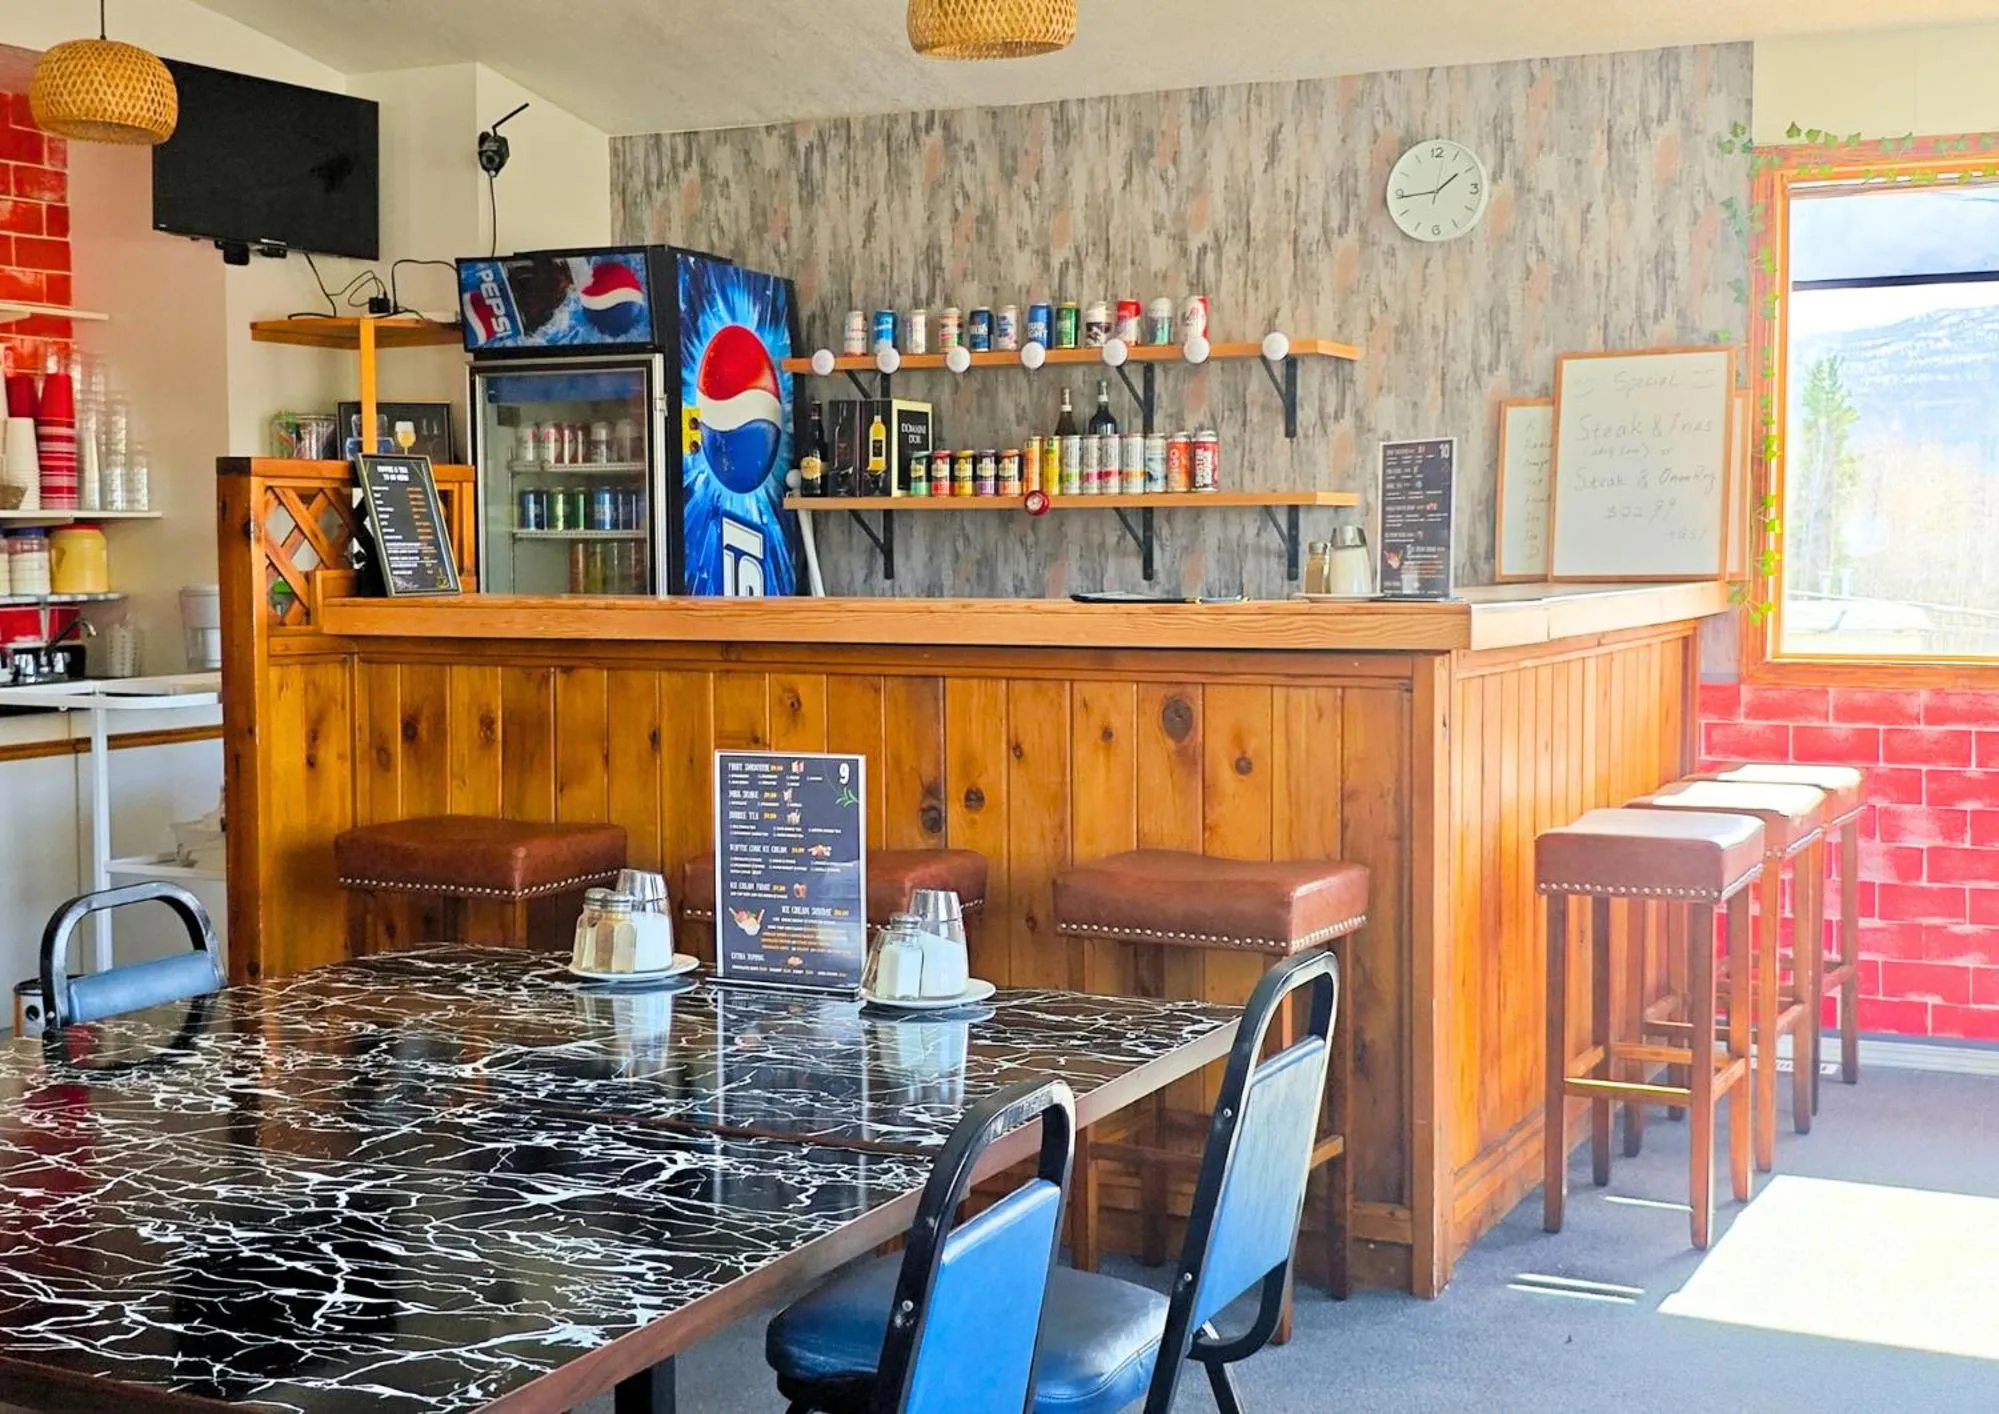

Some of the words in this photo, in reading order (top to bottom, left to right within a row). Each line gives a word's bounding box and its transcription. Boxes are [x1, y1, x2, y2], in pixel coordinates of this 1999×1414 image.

[1430, 147, 1445, 159] 12
[1395, 188, 1404, 199] 9
[1470, 183, 1480, 195] 3
[1431, 224, 1441, 236] 6
[476, 268, 512, 341] PEPSI
[1575, 411, 1643, 441] Steak
[1440, 444, 1450, 459] 10
[1573, 466, 1627, 492] Steak
[839, 762, 850, 784] 9
